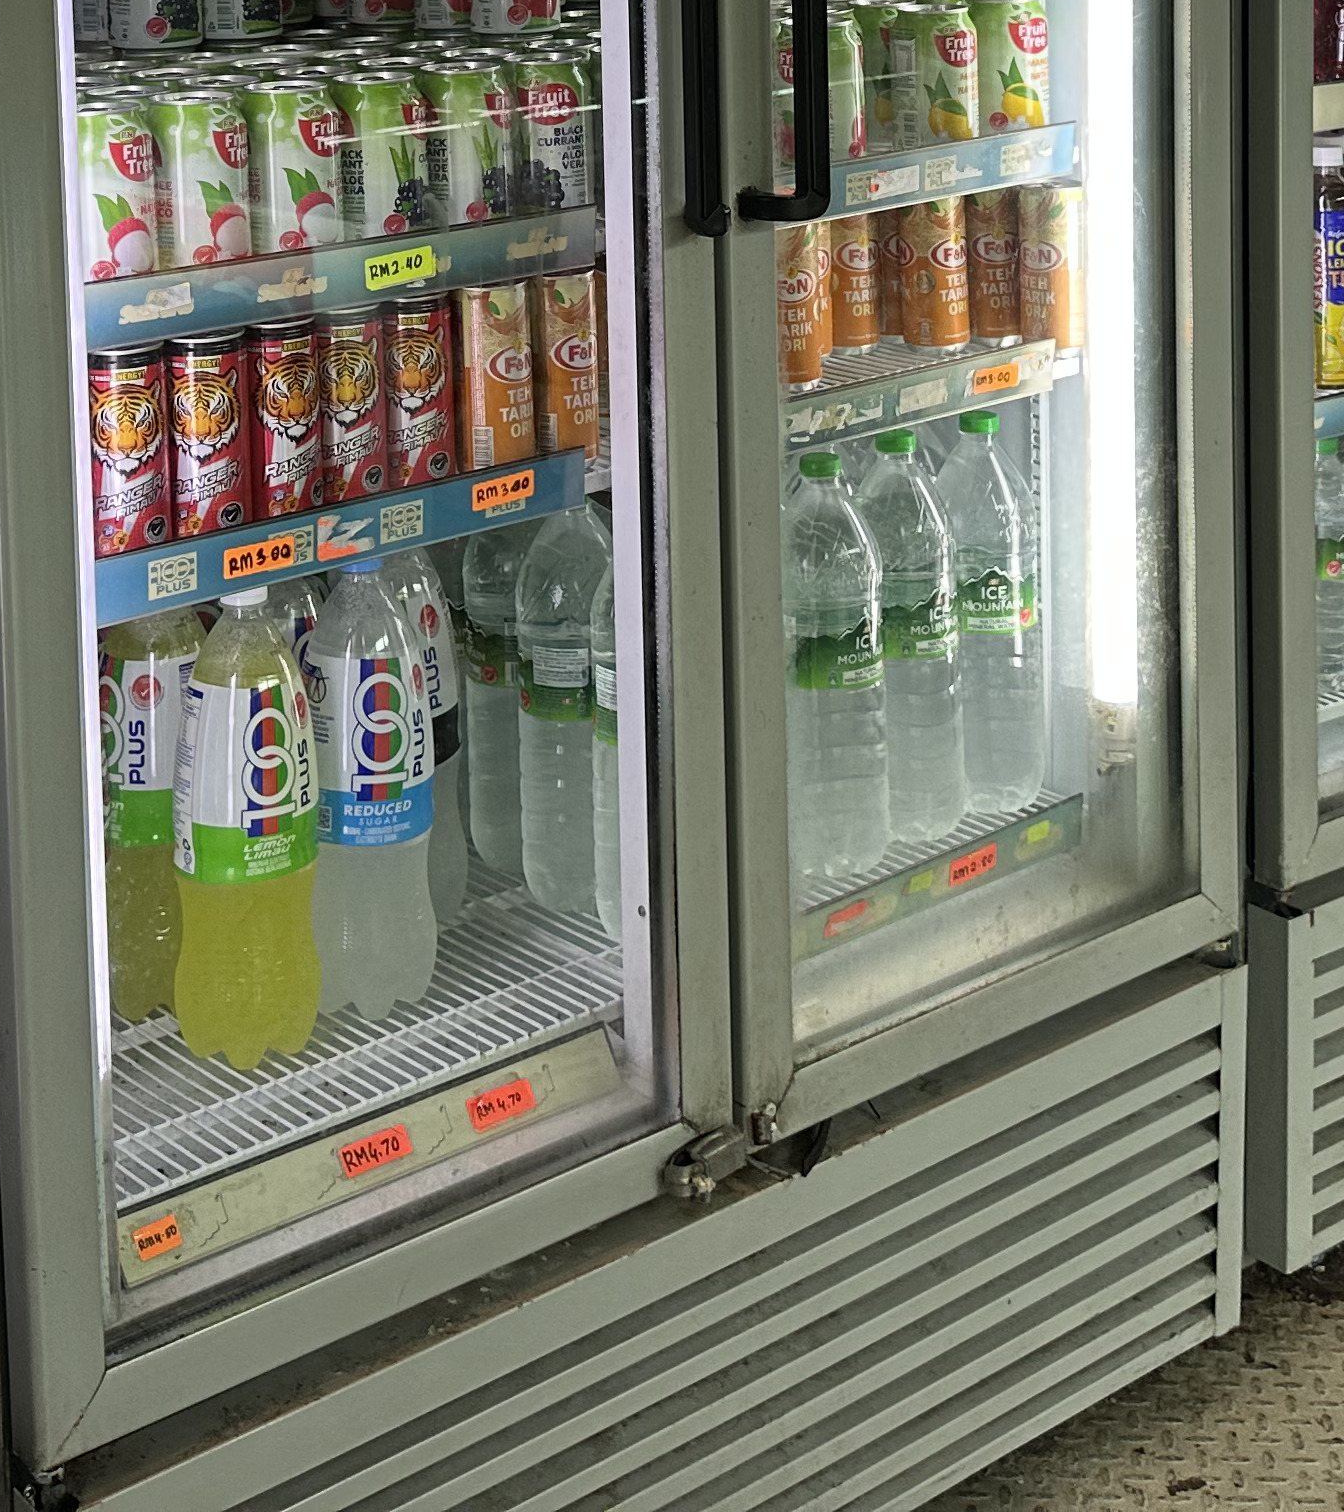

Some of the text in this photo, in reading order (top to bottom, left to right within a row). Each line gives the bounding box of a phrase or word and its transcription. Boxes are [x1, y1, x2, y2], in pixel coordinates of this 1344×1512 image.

[980, 585, 1008, 601] ICE
[423, 645, 443, 711] PLUS
[128, 720, 146, 785] PLUS
[412, 707, 424, 778] PLUS
[342, 798, 413, 817] REDUCED
[358, 815, 399, 826] SUGAR
